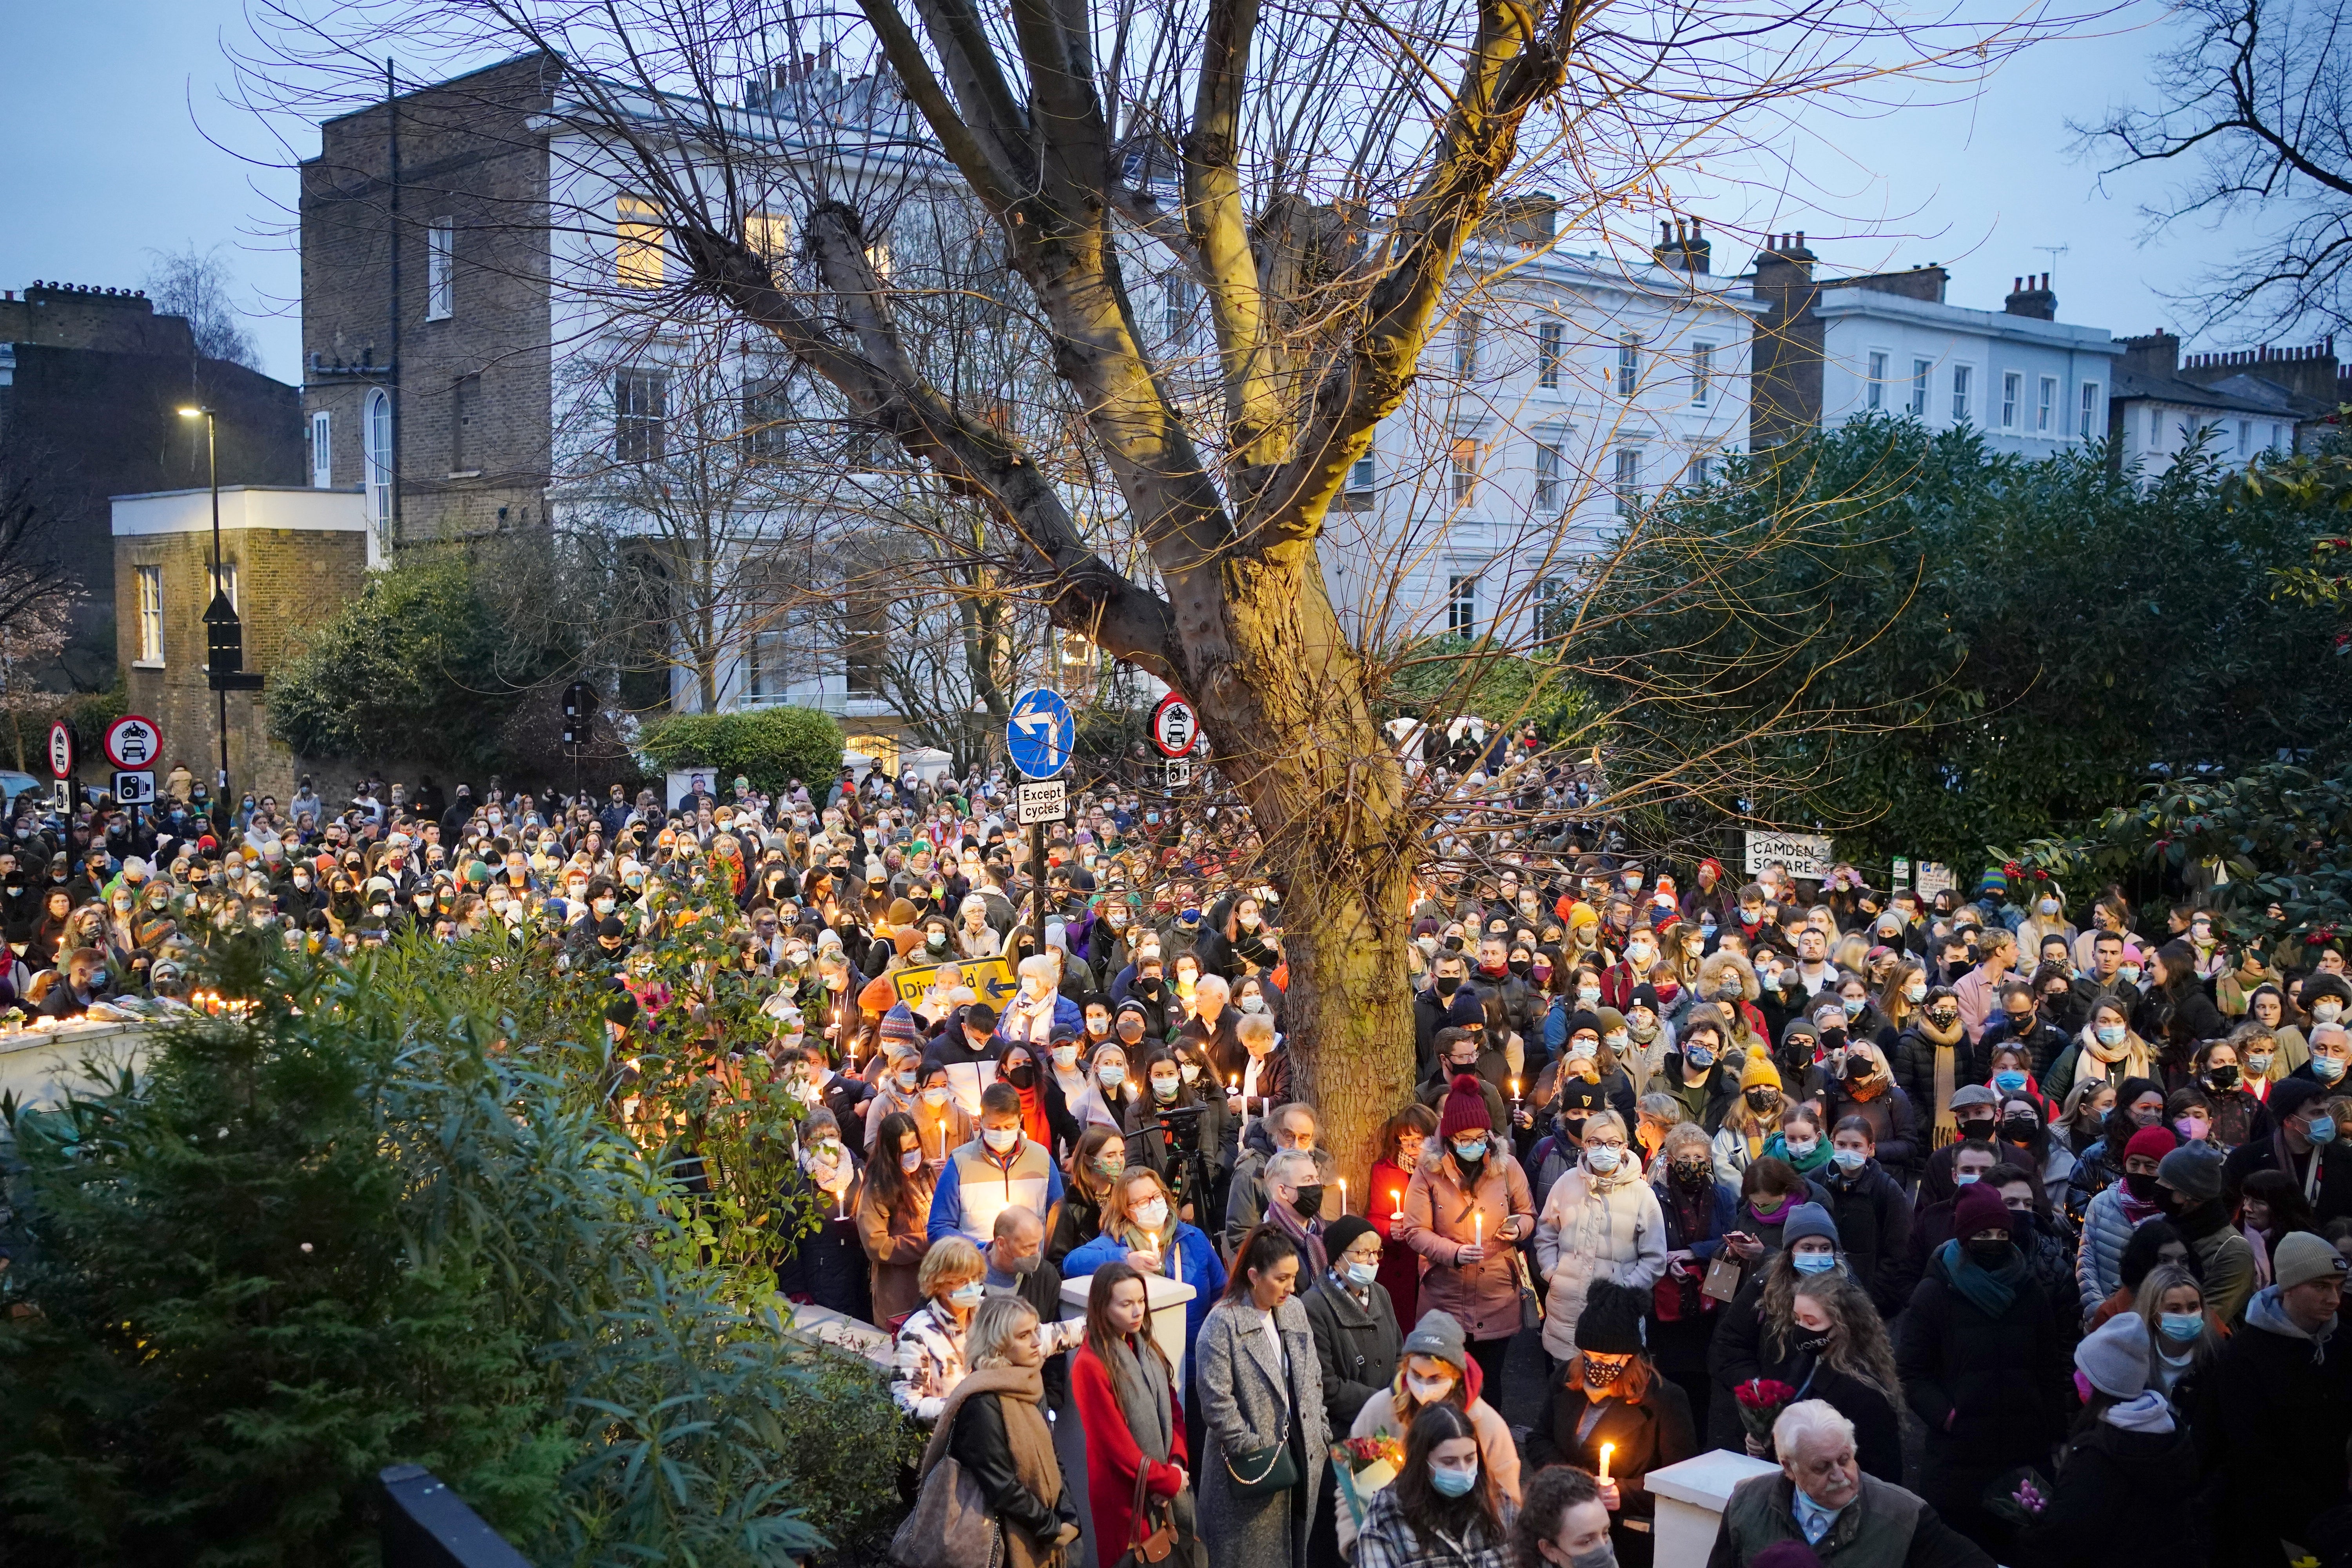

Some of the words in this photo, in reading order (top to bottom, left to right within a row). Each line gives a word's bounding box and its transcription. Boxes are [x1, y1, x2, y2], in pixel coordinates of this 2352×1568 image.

[1024, 787, 1061, 801] Except
[1026, 803, 1059, 818] cycles
[1753, 842, 1814, 856] CAMDEN
[1796, 1336, 1830, 1351] WOMEN
